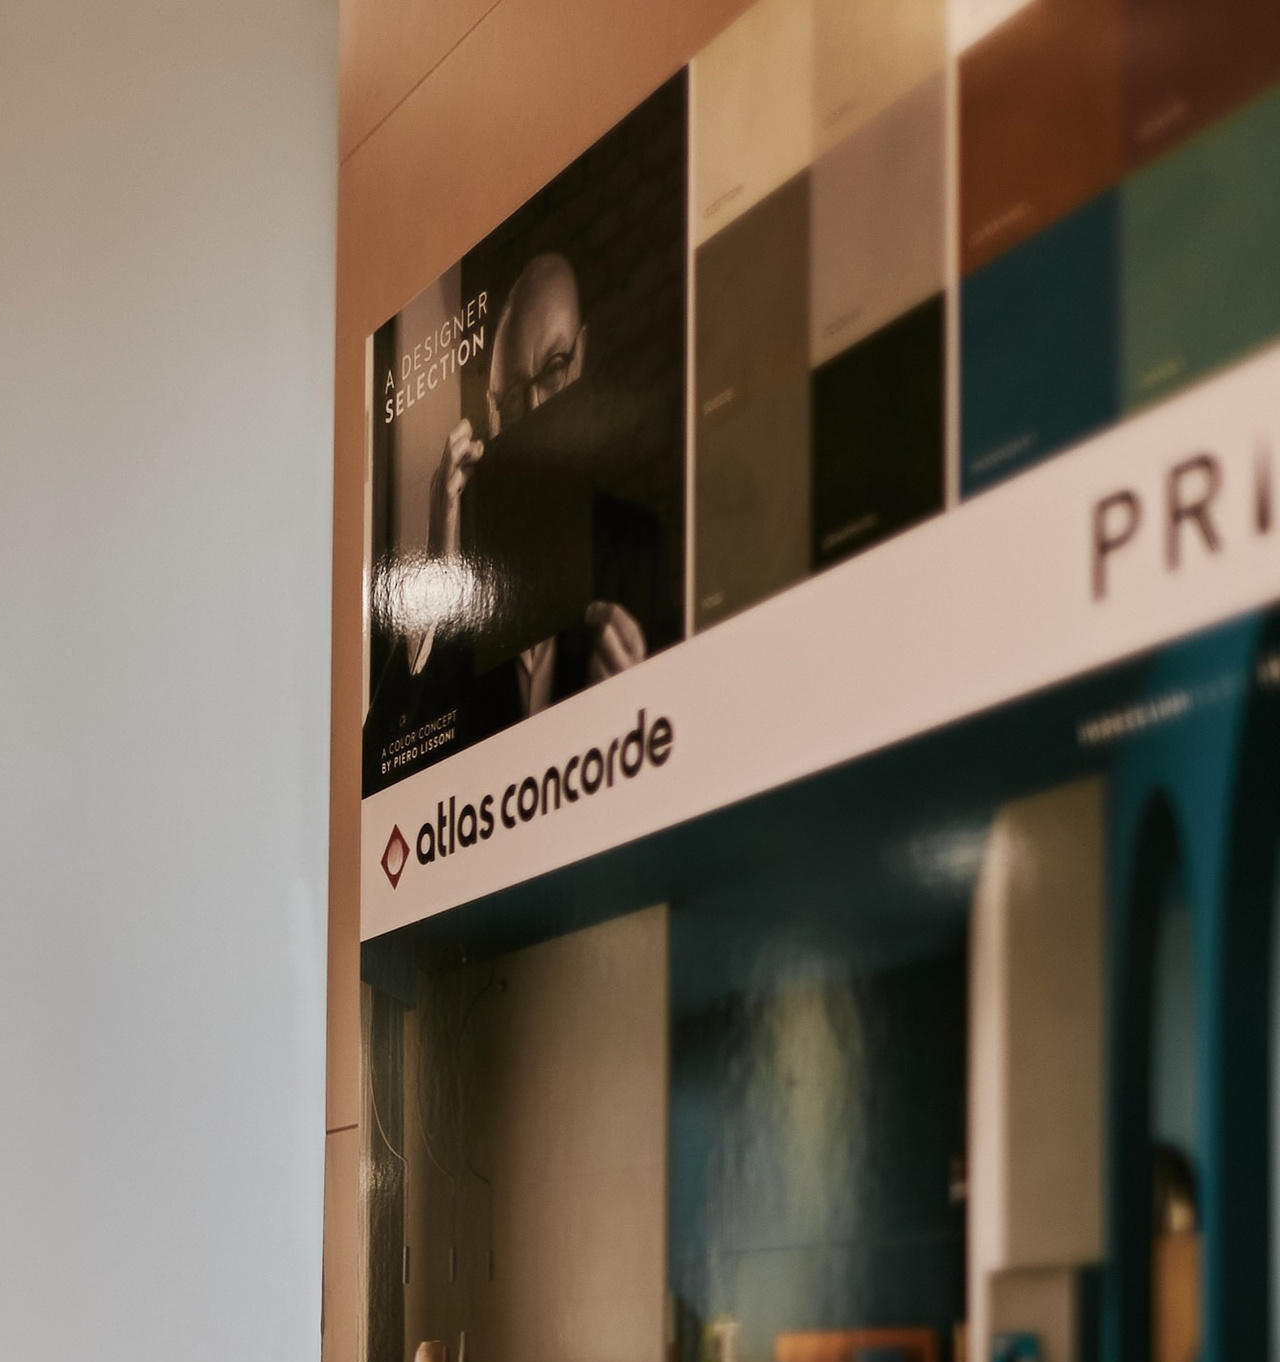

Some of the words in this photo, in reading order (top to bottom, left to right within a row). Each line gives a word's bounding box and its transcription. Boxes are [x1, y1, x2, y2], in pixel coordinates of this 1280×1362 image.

[385, 369, 395, 395] A
[401, 291, 488, 381] DESIGNER
[385, 325, 485, 424] SELECTION
[381, 760, 392, 775] BY
[393, 747, 418, 768] PIERO
[420, 727, 455, 755] LISSONI
[388, 731, 416, 755] COLOR
[418, 710, 457, 740] CONCEPT
[416, 796, 495, 866] atlas
[500, 708, 673, 830] concorde
